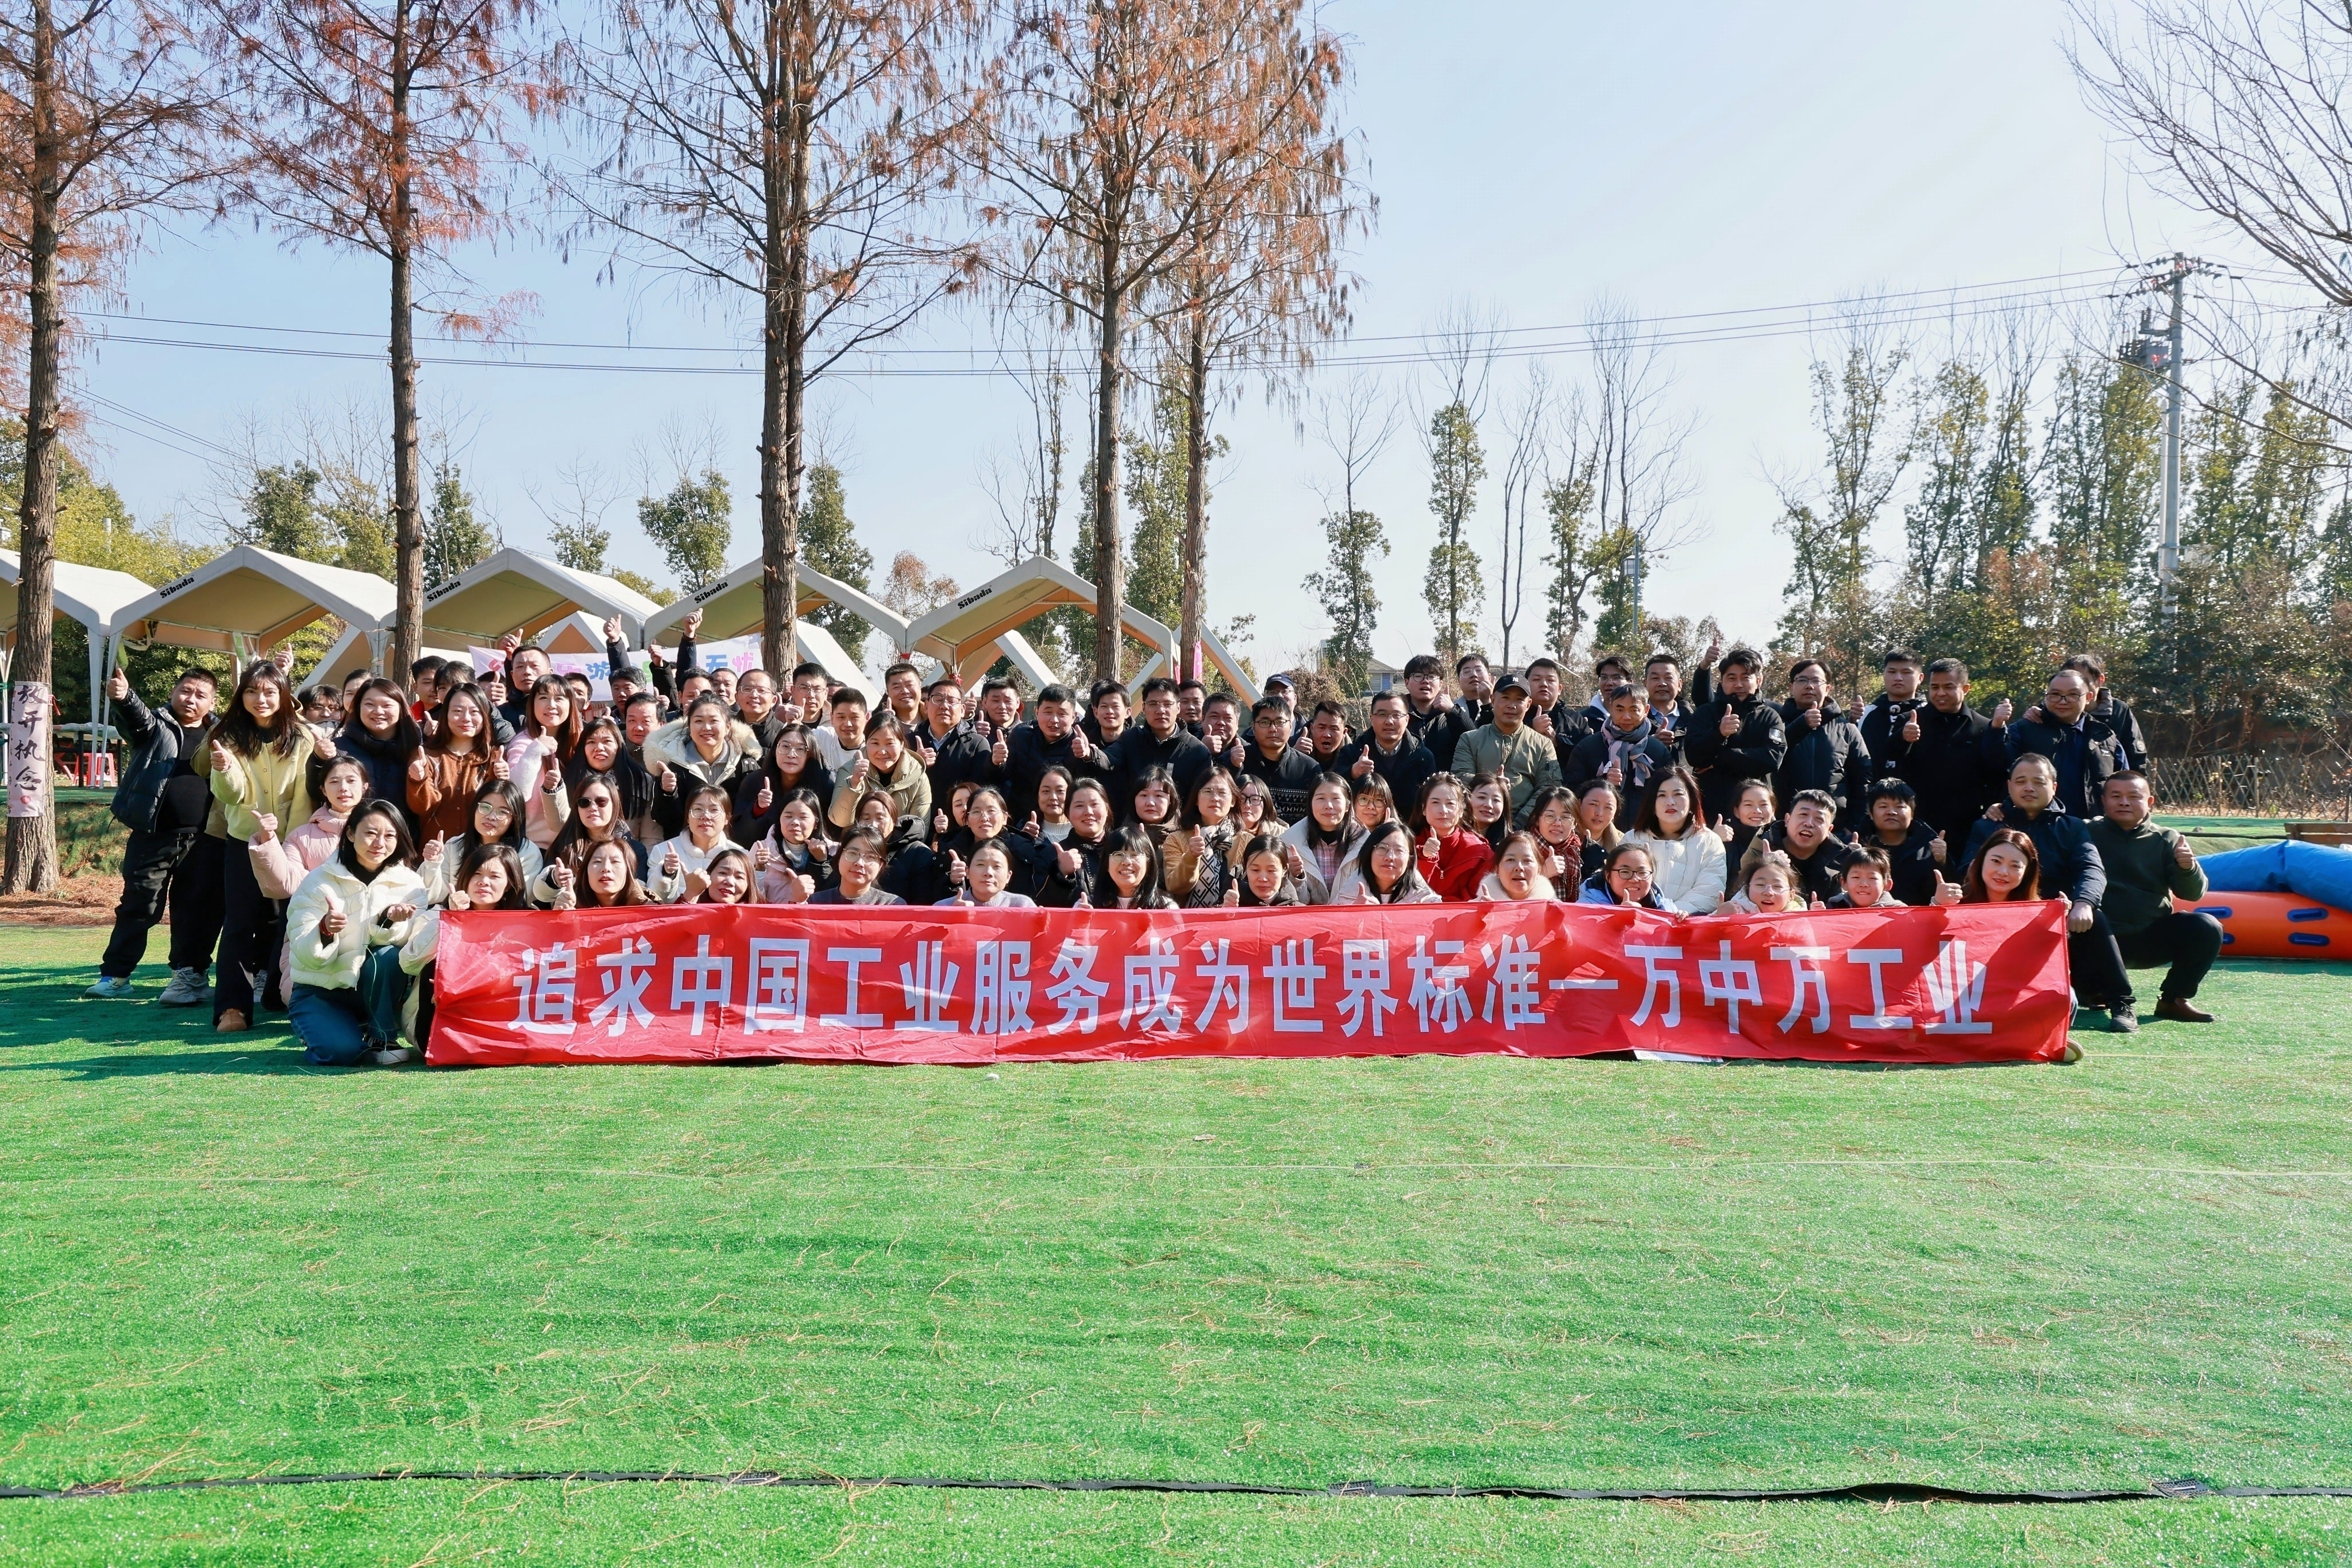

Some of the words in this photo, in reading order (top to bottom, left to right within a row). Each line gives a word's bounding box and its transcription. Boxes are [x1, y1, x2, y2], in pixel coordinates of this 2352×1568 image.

[160, 577, 195, 598] Sibada
[426, 581, 461, 602] Sibada
[694, 582, 728, 604] Sibada
[957, 588, 992, 609] Sibada
[14, 685, 48, 791] 放开执念
